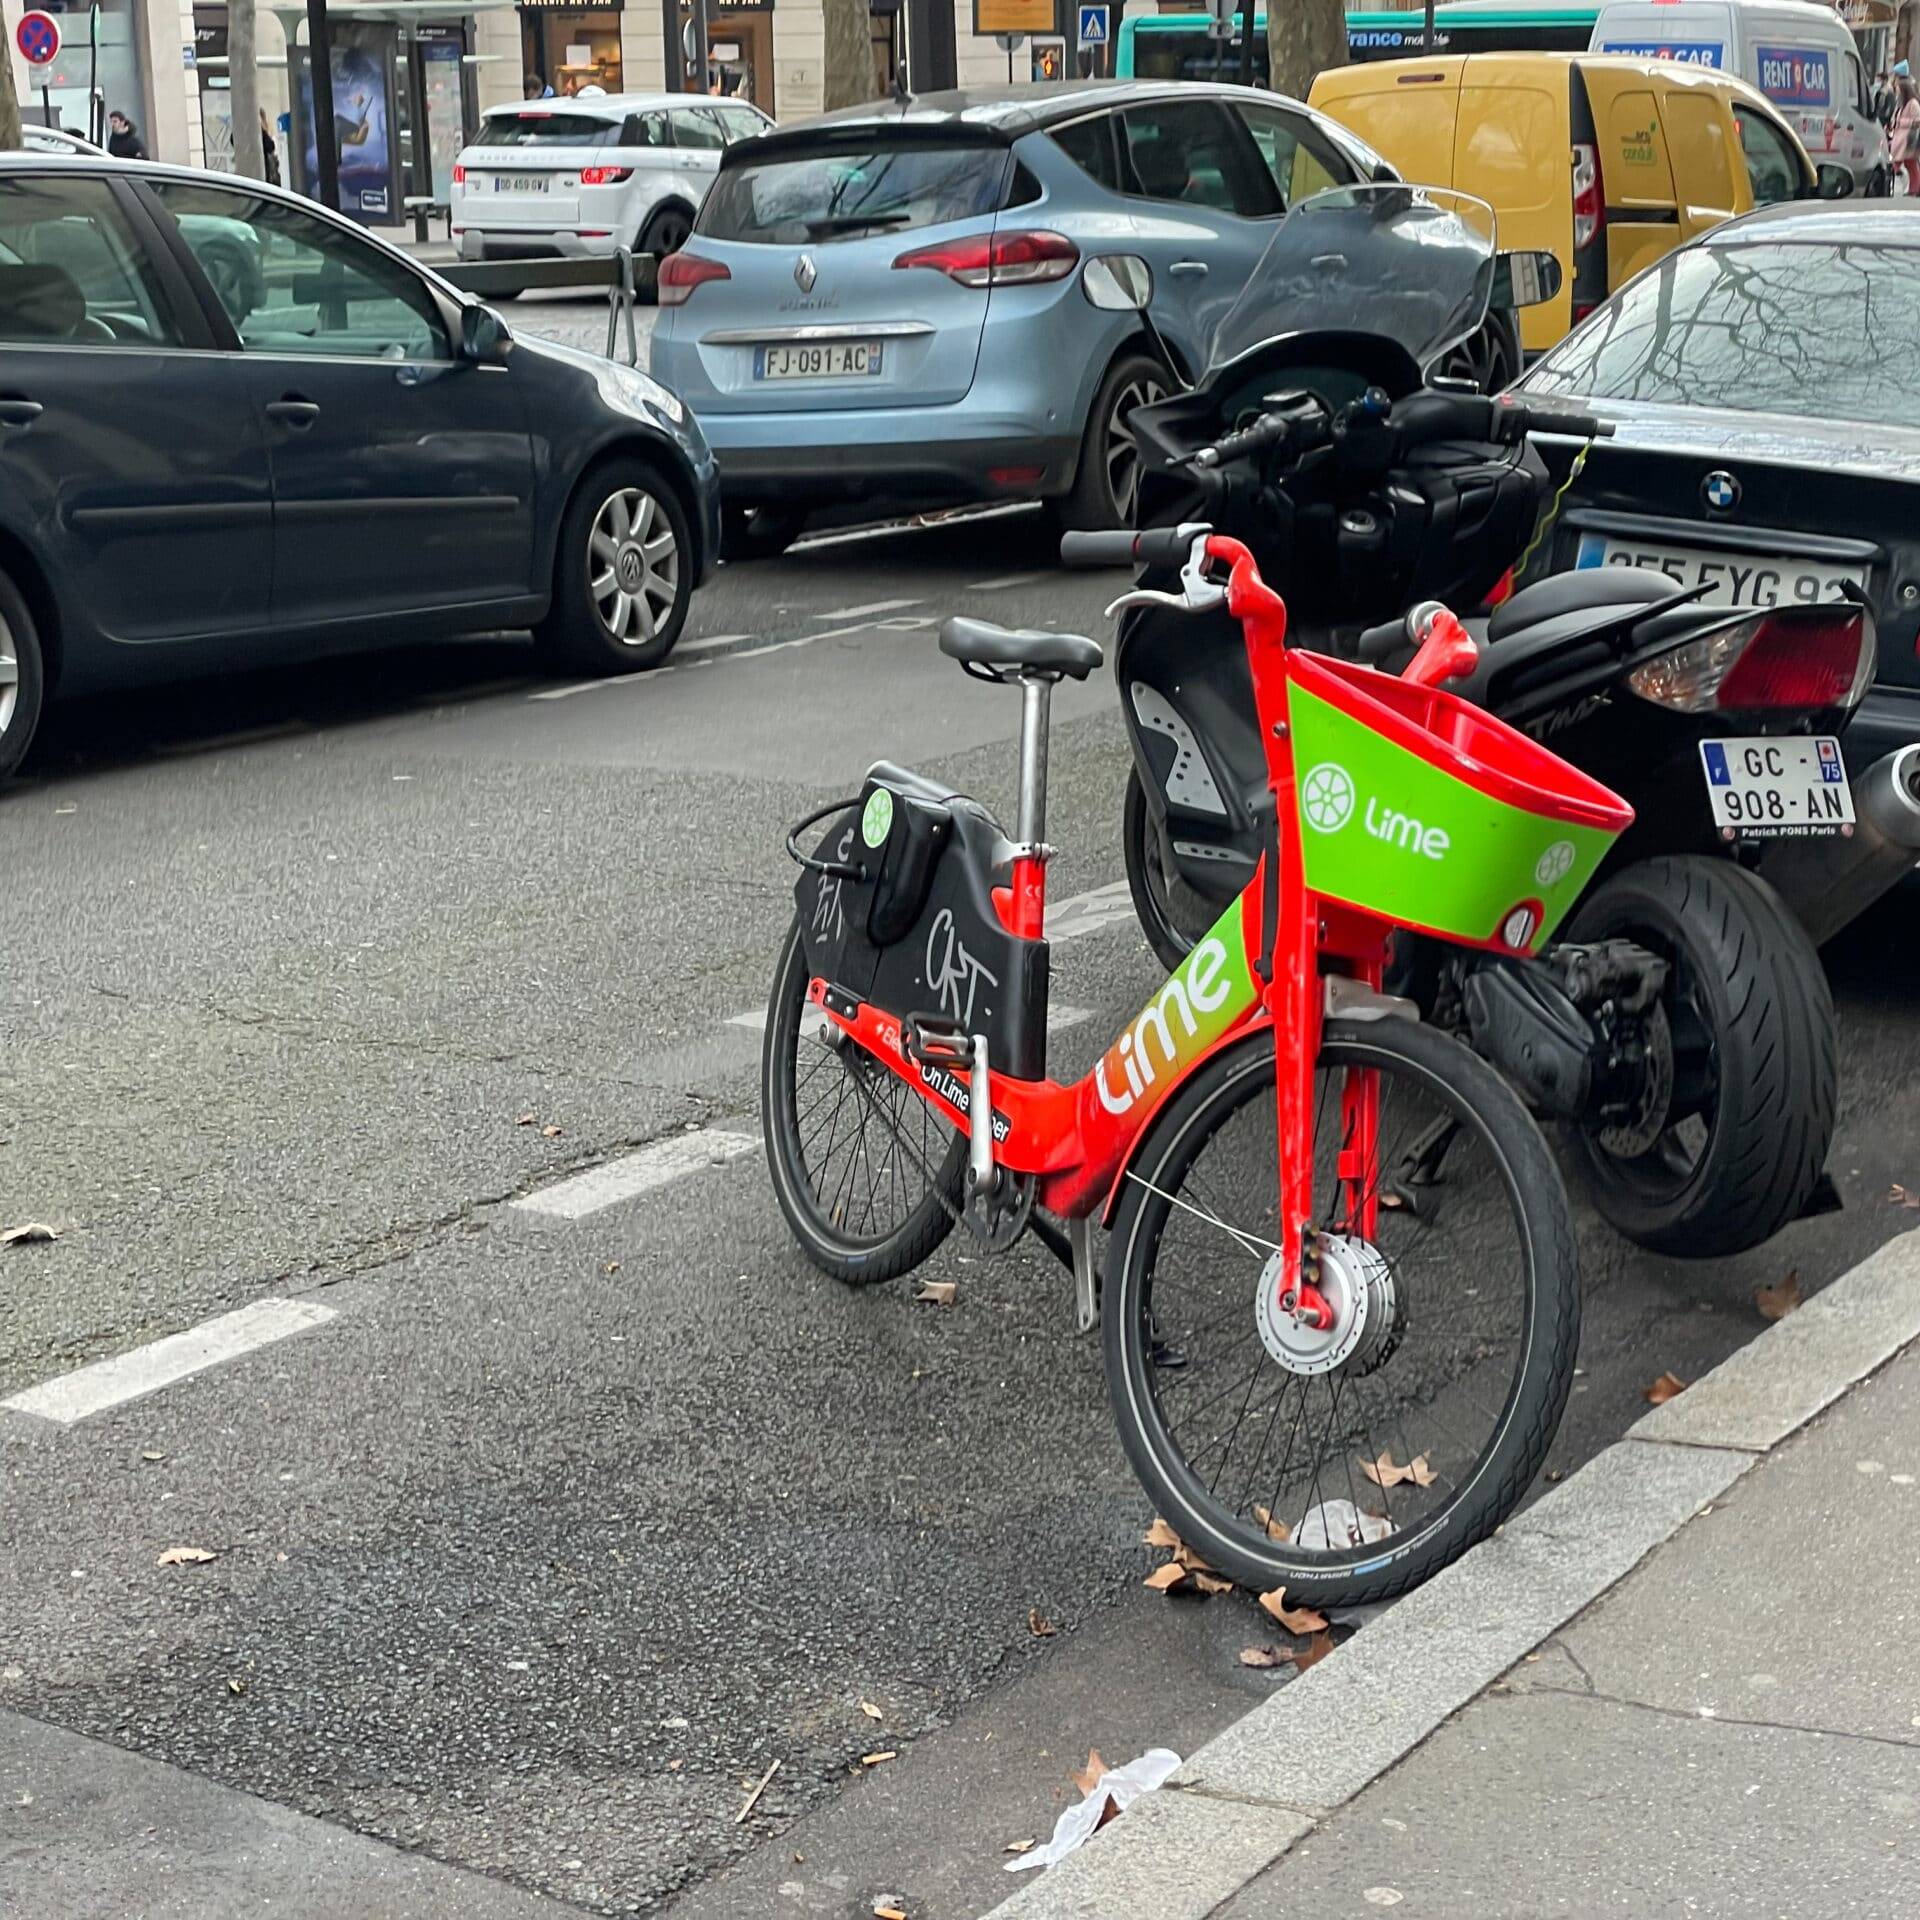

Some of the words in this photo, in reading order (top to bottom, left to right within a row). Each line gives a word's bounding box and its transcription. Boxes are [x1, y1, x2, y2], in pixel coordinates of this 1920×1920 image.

[1763, 59, 1792, 88] RENT
[1803, 62, 1826, 91] CAR
[1744, 747, 1784, 777] GC
[1822, 763, 1840, 780] 75
[1364, 796, 1451, 861] Lime
[1742, 827, 1778, 837] Patrick
[1811, 825, 1836, 835] Paris
[1094, 937, 1232, 1115] Lime
[921, 1065, 942, 1090] On
[940, 1073, 970, 1112] Lime
